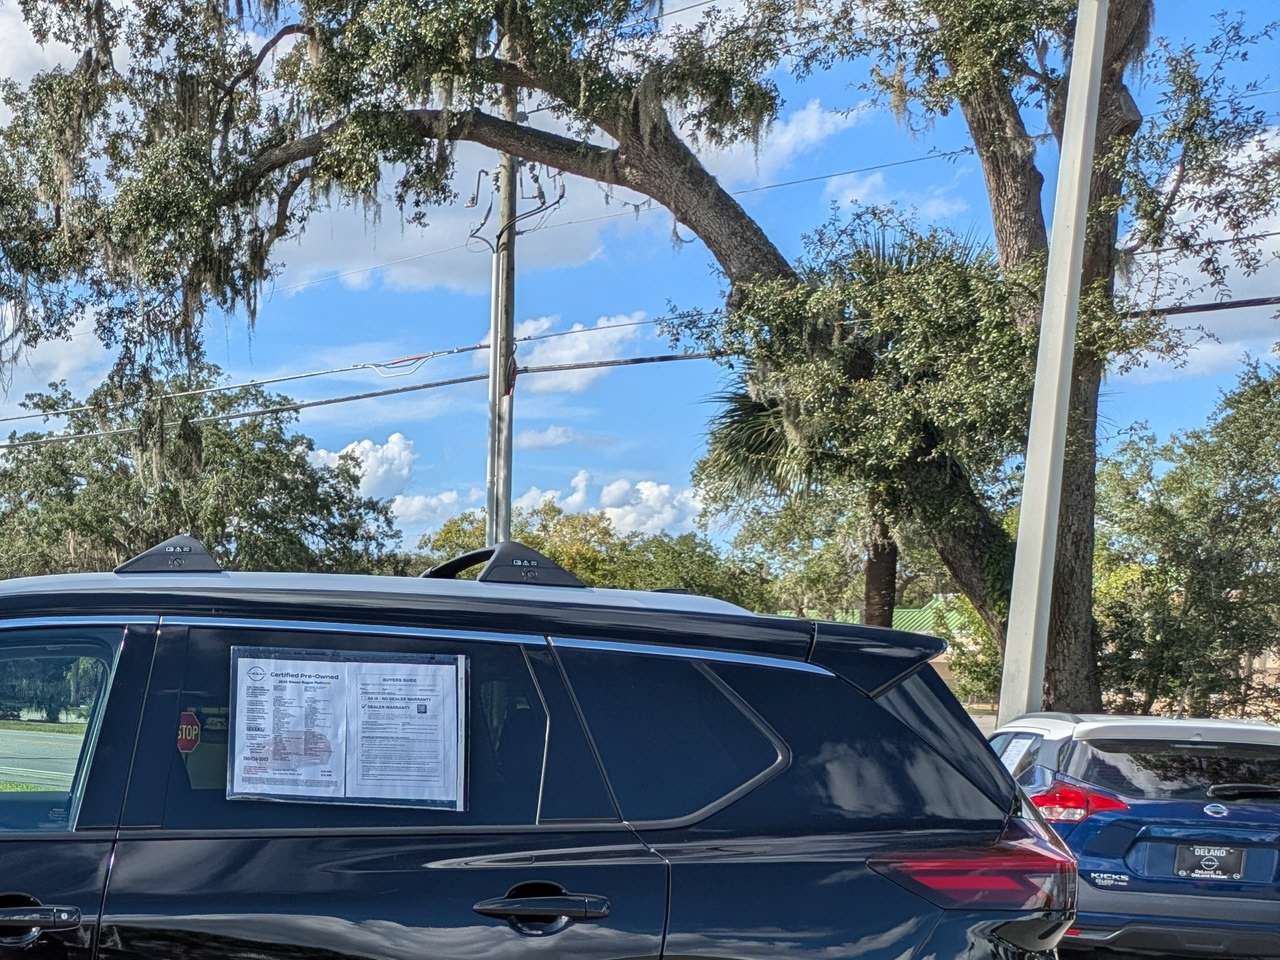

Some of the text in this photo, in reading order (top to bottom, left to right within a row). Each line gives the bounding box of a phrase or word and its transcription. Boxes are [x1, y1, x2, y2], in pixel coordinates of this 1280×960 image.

[270, 671, 299, 679] Certified
[177, 725, 198, 740] STOP
[1195, 848, 1226, 857] DELAND
[1090, 872, 1129, 881] KICKS
